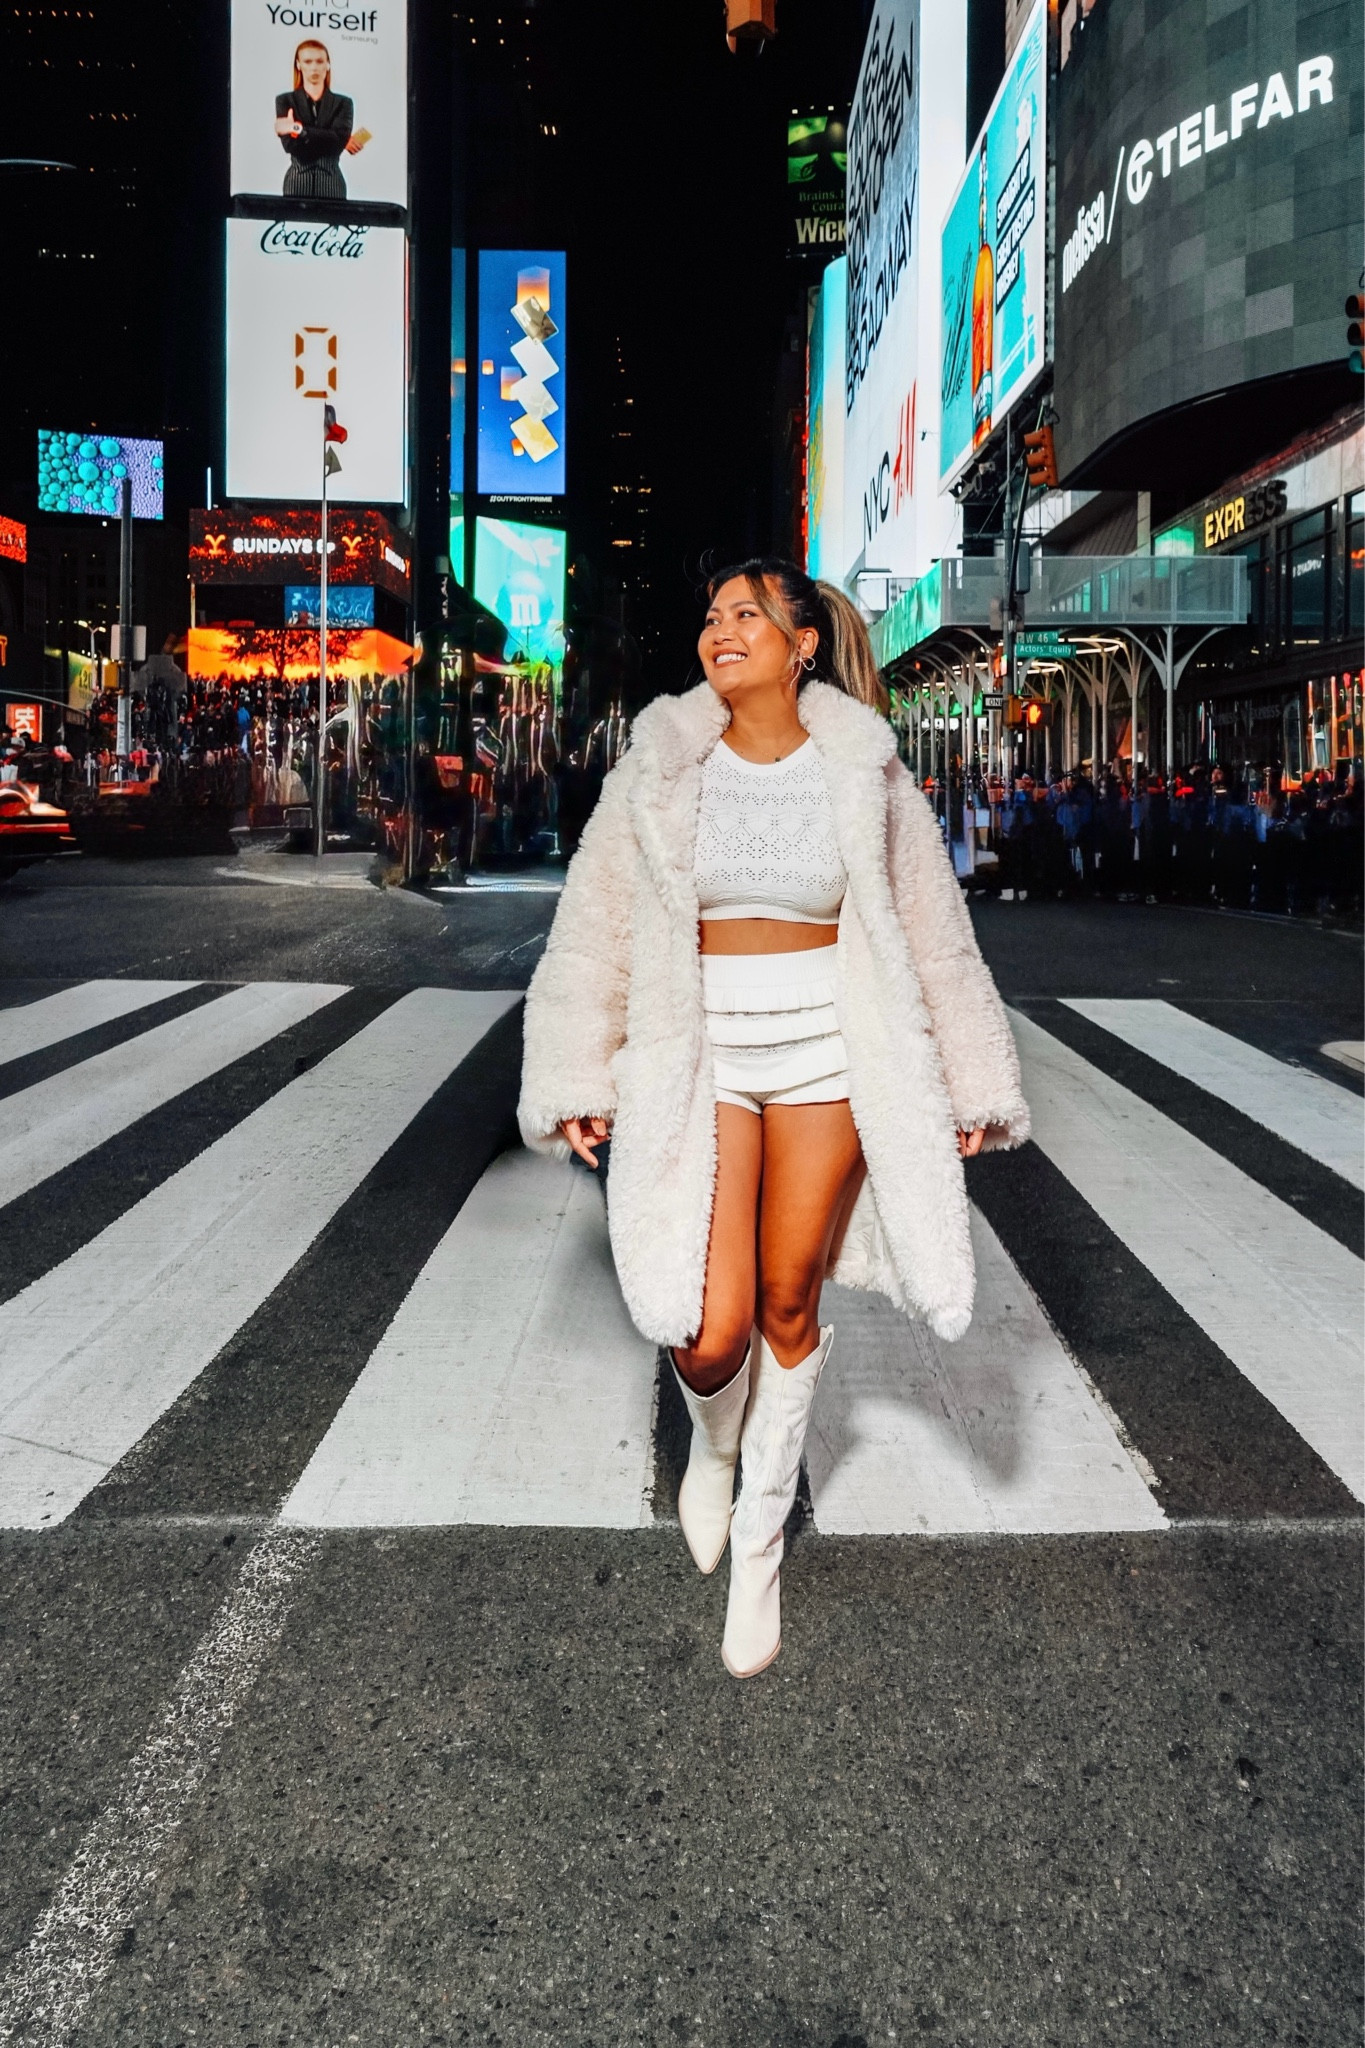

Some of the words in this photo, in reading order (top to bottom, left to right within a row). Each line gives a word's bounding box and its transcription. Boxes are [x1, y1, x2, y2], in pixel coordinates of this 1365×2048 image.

[266, 4, 378, 32] Yourself
[848, 17, 895, 240] SQUARE
[849, 15, 880, 181] TIMES
[872, 20, 913, 216] OPEN
[812, 201, 845, 212] Coura
[1063, 191, 1104, 293] melissa
[1157, 55, 1334, 178] TELFAR
[847, 169, 916, 418] BROADWAY
[864, 450, 890, 542] NYC
[1205, 480, 1287, 548] EXPRESS
[232, 537, 313, 554] SUNDAYS
[1019, 645, 1046, 653] Actors'
[1049, 646, 1072, 654] Equity
[1026, 634, 1034, 643] W
[1037, 633, 1048, 644] 46
